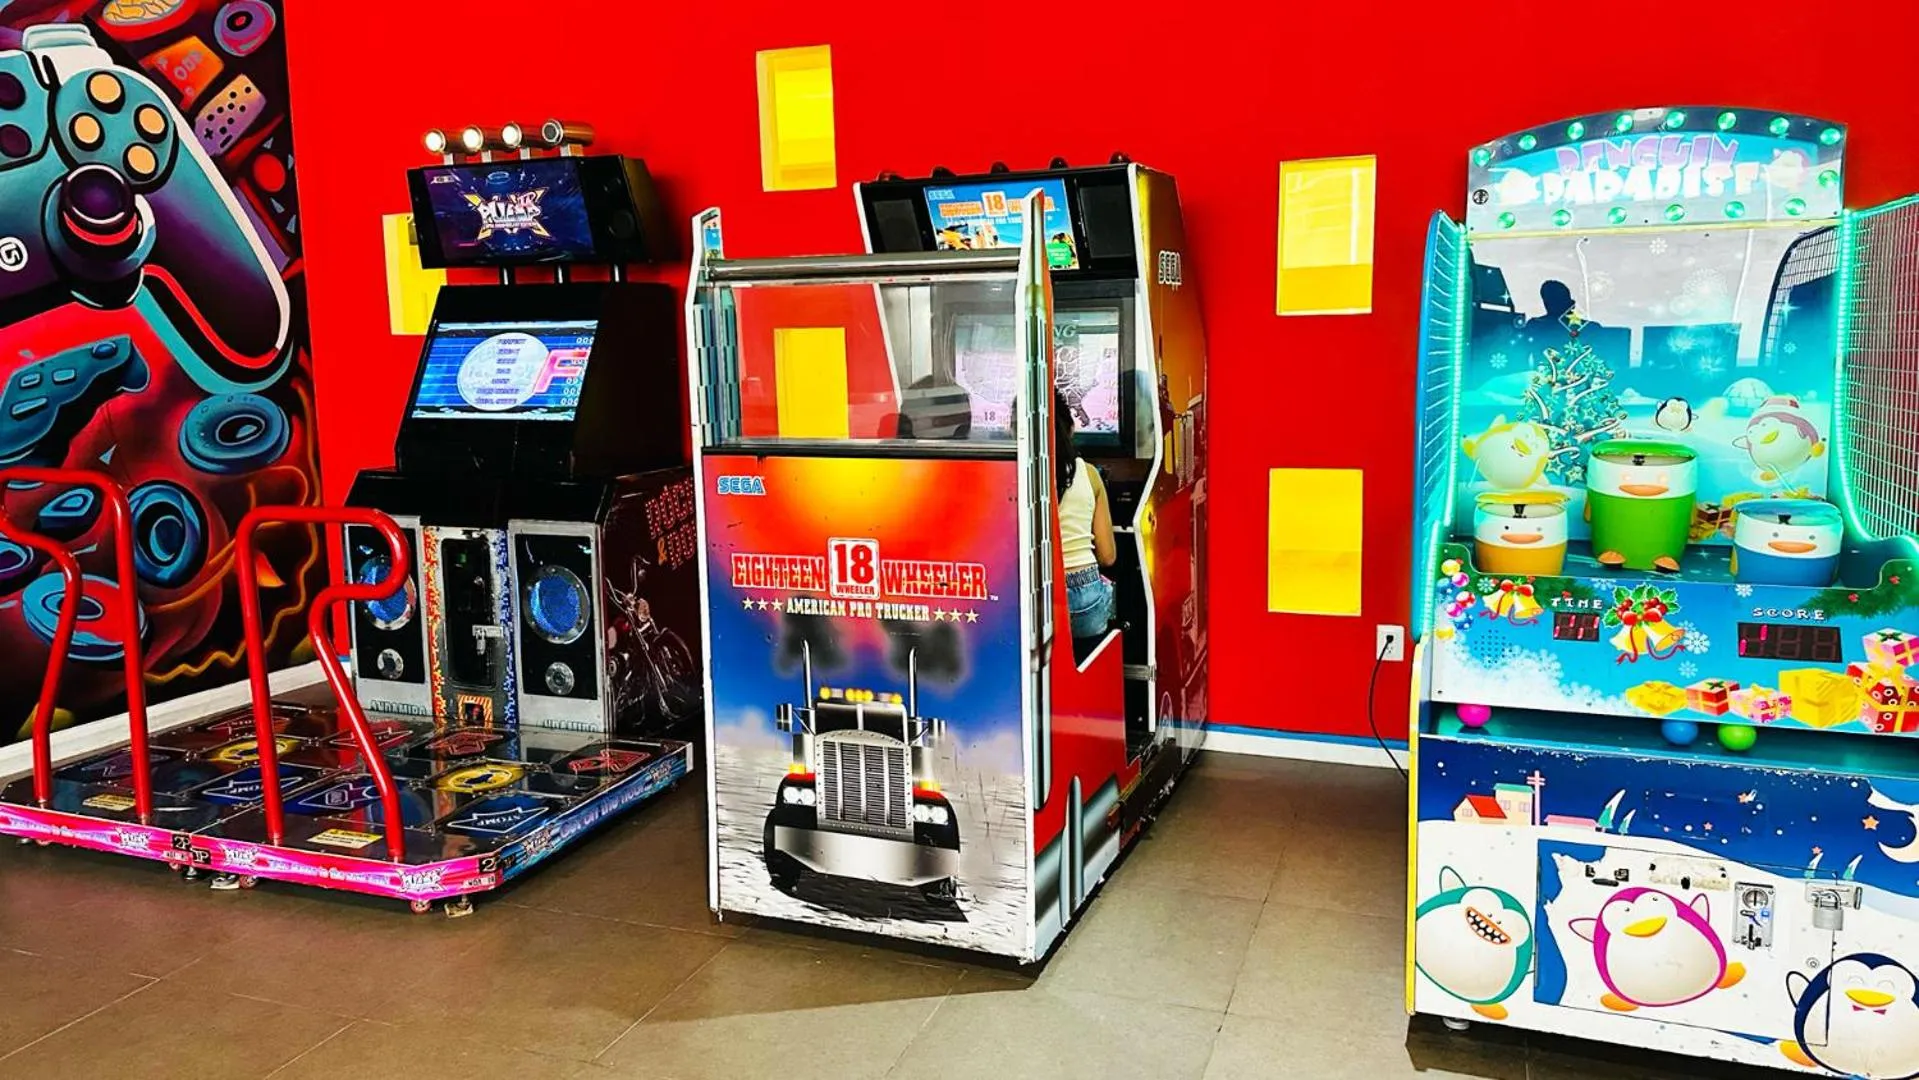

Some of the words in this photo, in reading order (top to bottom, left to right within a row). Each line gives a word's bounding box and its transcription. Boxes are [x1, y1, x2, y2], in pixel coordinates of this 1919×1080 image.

[1556, 134, 1738, 171] PENGUIN
[984, 194, 1004, 213] 18
[717, 476, 766, 495] SEGA
[731, 553, 826, 591] EIGHTEEN
[834, 543, 874, 584] 18
[836, 584, 875, 595] WHEELER
[883, 560, 987, 600] WHEELER
[786, 597, 846, 617] AMERICAN
[849, 601, 872, 618] PRO
[875, 602, 930, 621] TRUCKER
[1551, 597, 1603, 609] TIME
[1752, 607, 1825, 620] SCORE
